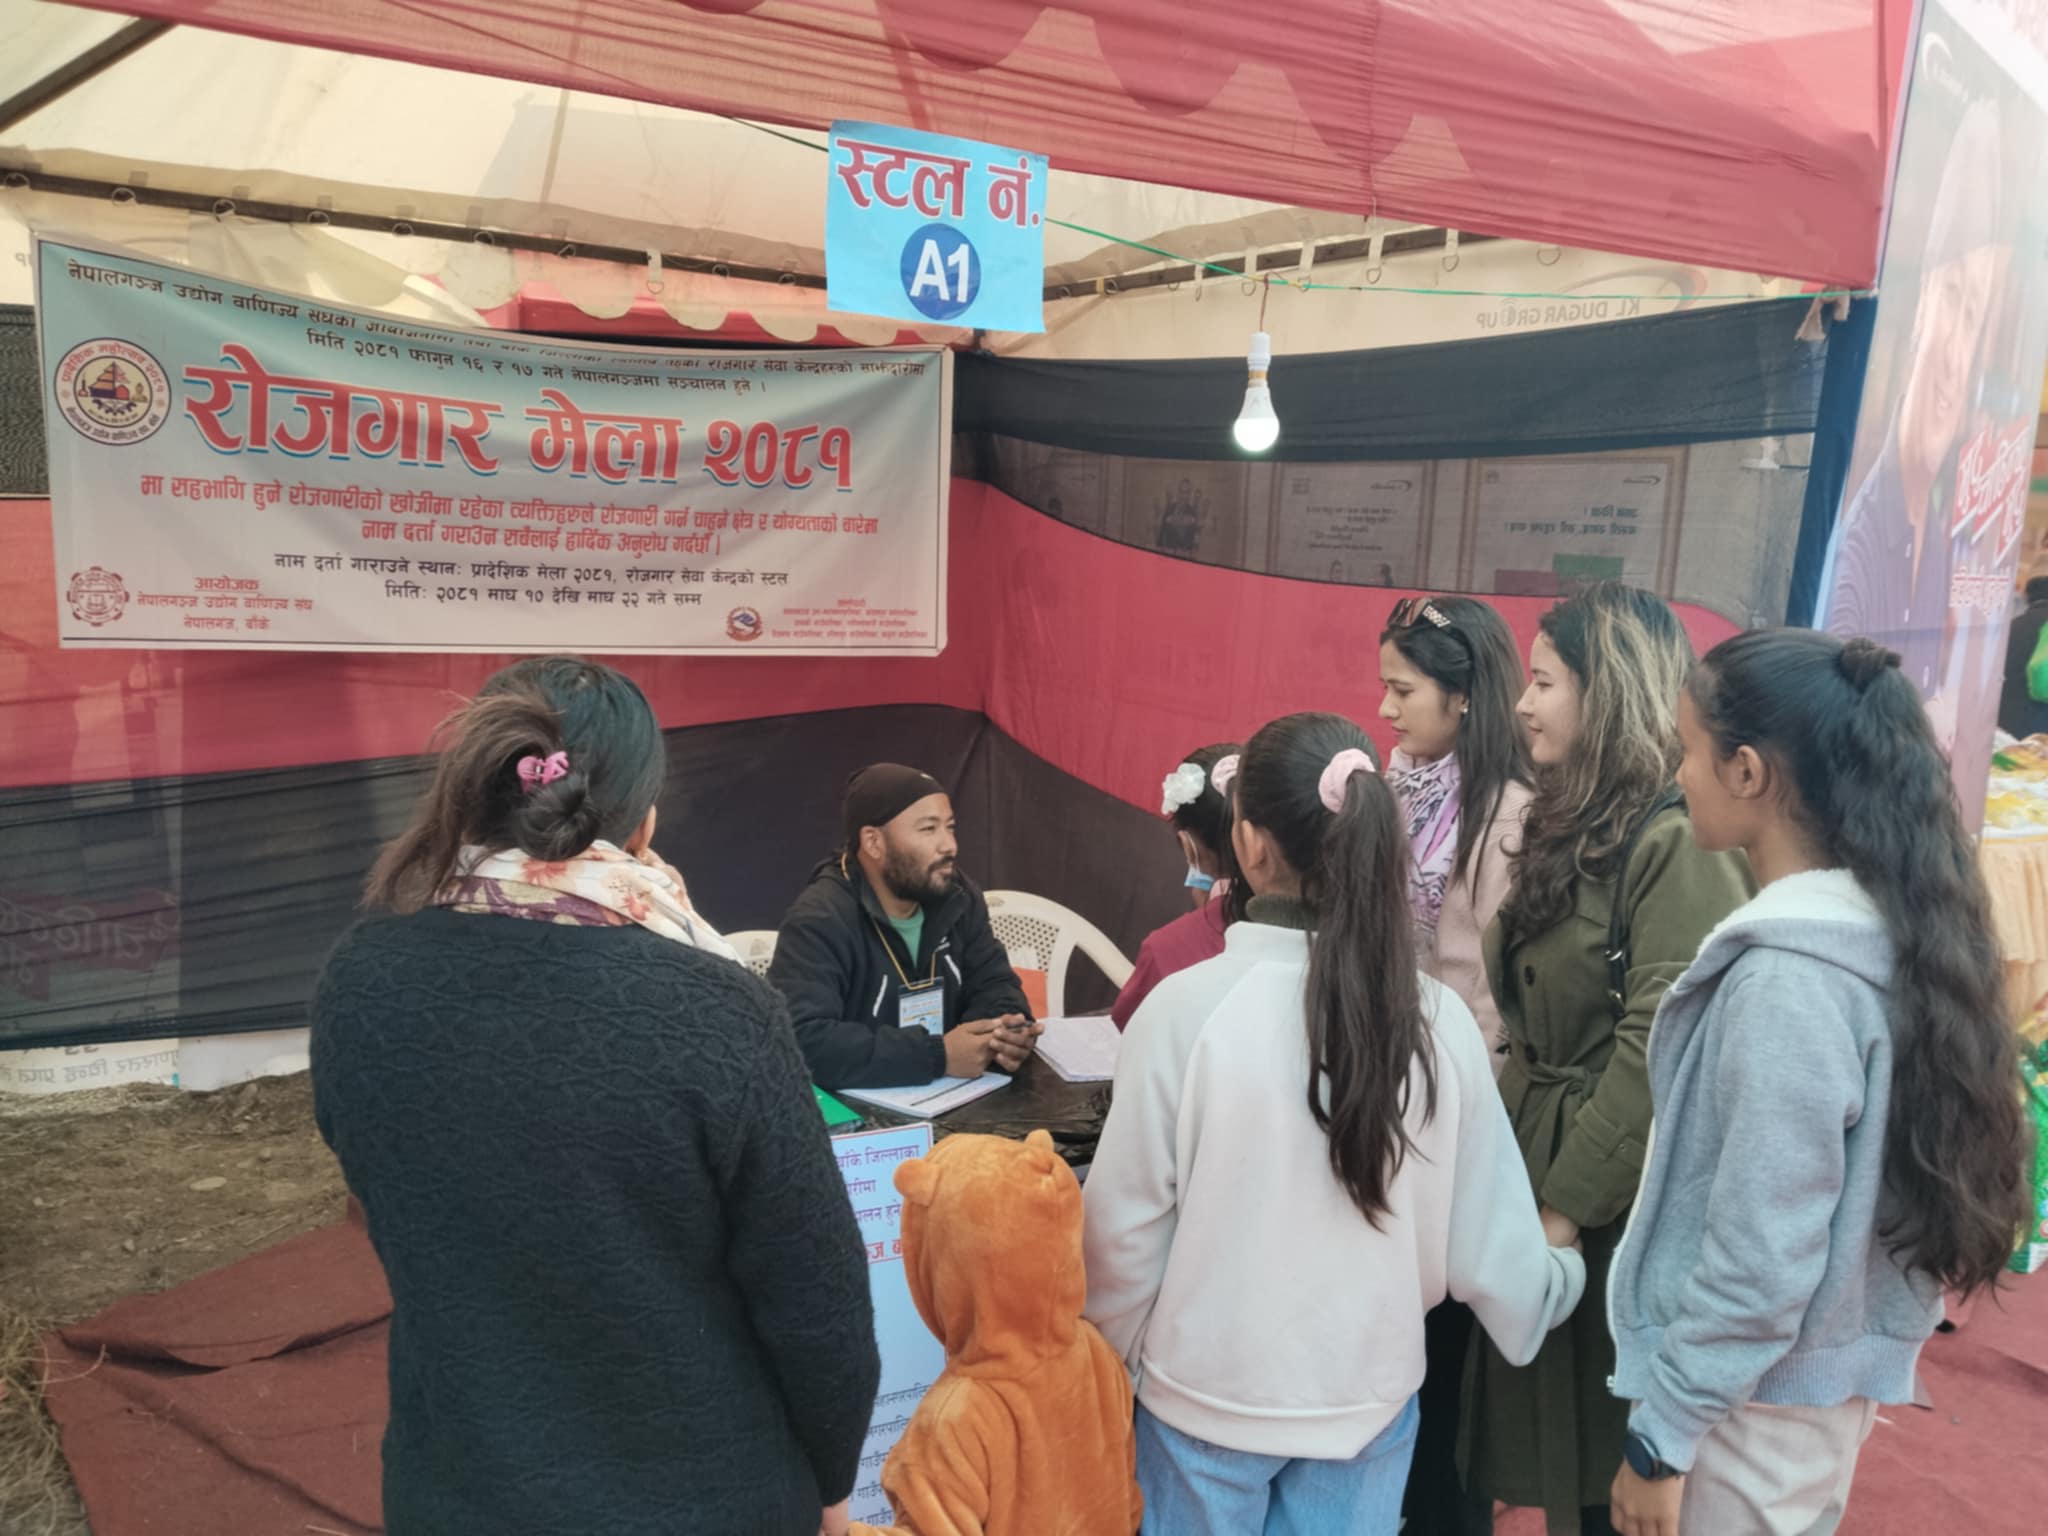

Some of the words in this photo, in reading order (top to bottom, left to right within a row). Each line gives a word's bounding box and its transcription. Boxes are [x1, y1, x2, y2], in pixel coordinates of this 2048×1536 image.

[835, 137, 971, 218] स्टल
[987, 156, 1041, 227] नं.
[173, 284, 224, 305] उद्योग
[910, 239, 970, 303] A1
[307, 327, 345, 350] मिति
[354, 340, 399, 359] २०८१
[408, 346, 454, 370] फागुन
[462, 356, 485, 373] १६
[492, 359, 504, 375] र
[511, 362, 533, 377] १७
[543, 364, 563, 380] गते
[183, 342, 503, 477] रोजगार
[523, 387, 686, 485] मेला
[702, 419, 854, 493] २०८१
[141, 474, 163, 496] मा
[253, 479, 283, 511] हुने
[288, 481, 383, 511] रोजगारीको
[389, 489, 453, 515] खोजीमा
[459, 495, 504, 519] रहेका
[601, 504, 658, 526] रोजगारी
[758, 513, 768, 531] र
[362, 519, 398, 541] नाम
[403, 519, 437, 543] दर्ता
[565, 527, 613, 552] हार्दिक
[618, 531, 668, 559] अनुरोध
[274, 553, 306, 568] नाम
[313, 551, 343, 571] दर्ता
[471, 560, 530, 580] प्रादेशिक
[537, 562, 567, 580] मेला
[626, 565, 675, 585] रोजगार
[681, 566, 704, 583] सेवा
[761, 571, 789, 586] स्टल
[436, 586, 479, 603] २०८१
[488, 586, 518, 601] माघ
[525, 587, 544, 602] १०
[552, 586, 582, 604] देखि
[587, 590, 620, 604] माघ
[622, 592, 640, 607] २२
[647, 590, 667, 605] गते
[673, 592, 702, 606] सम्म
